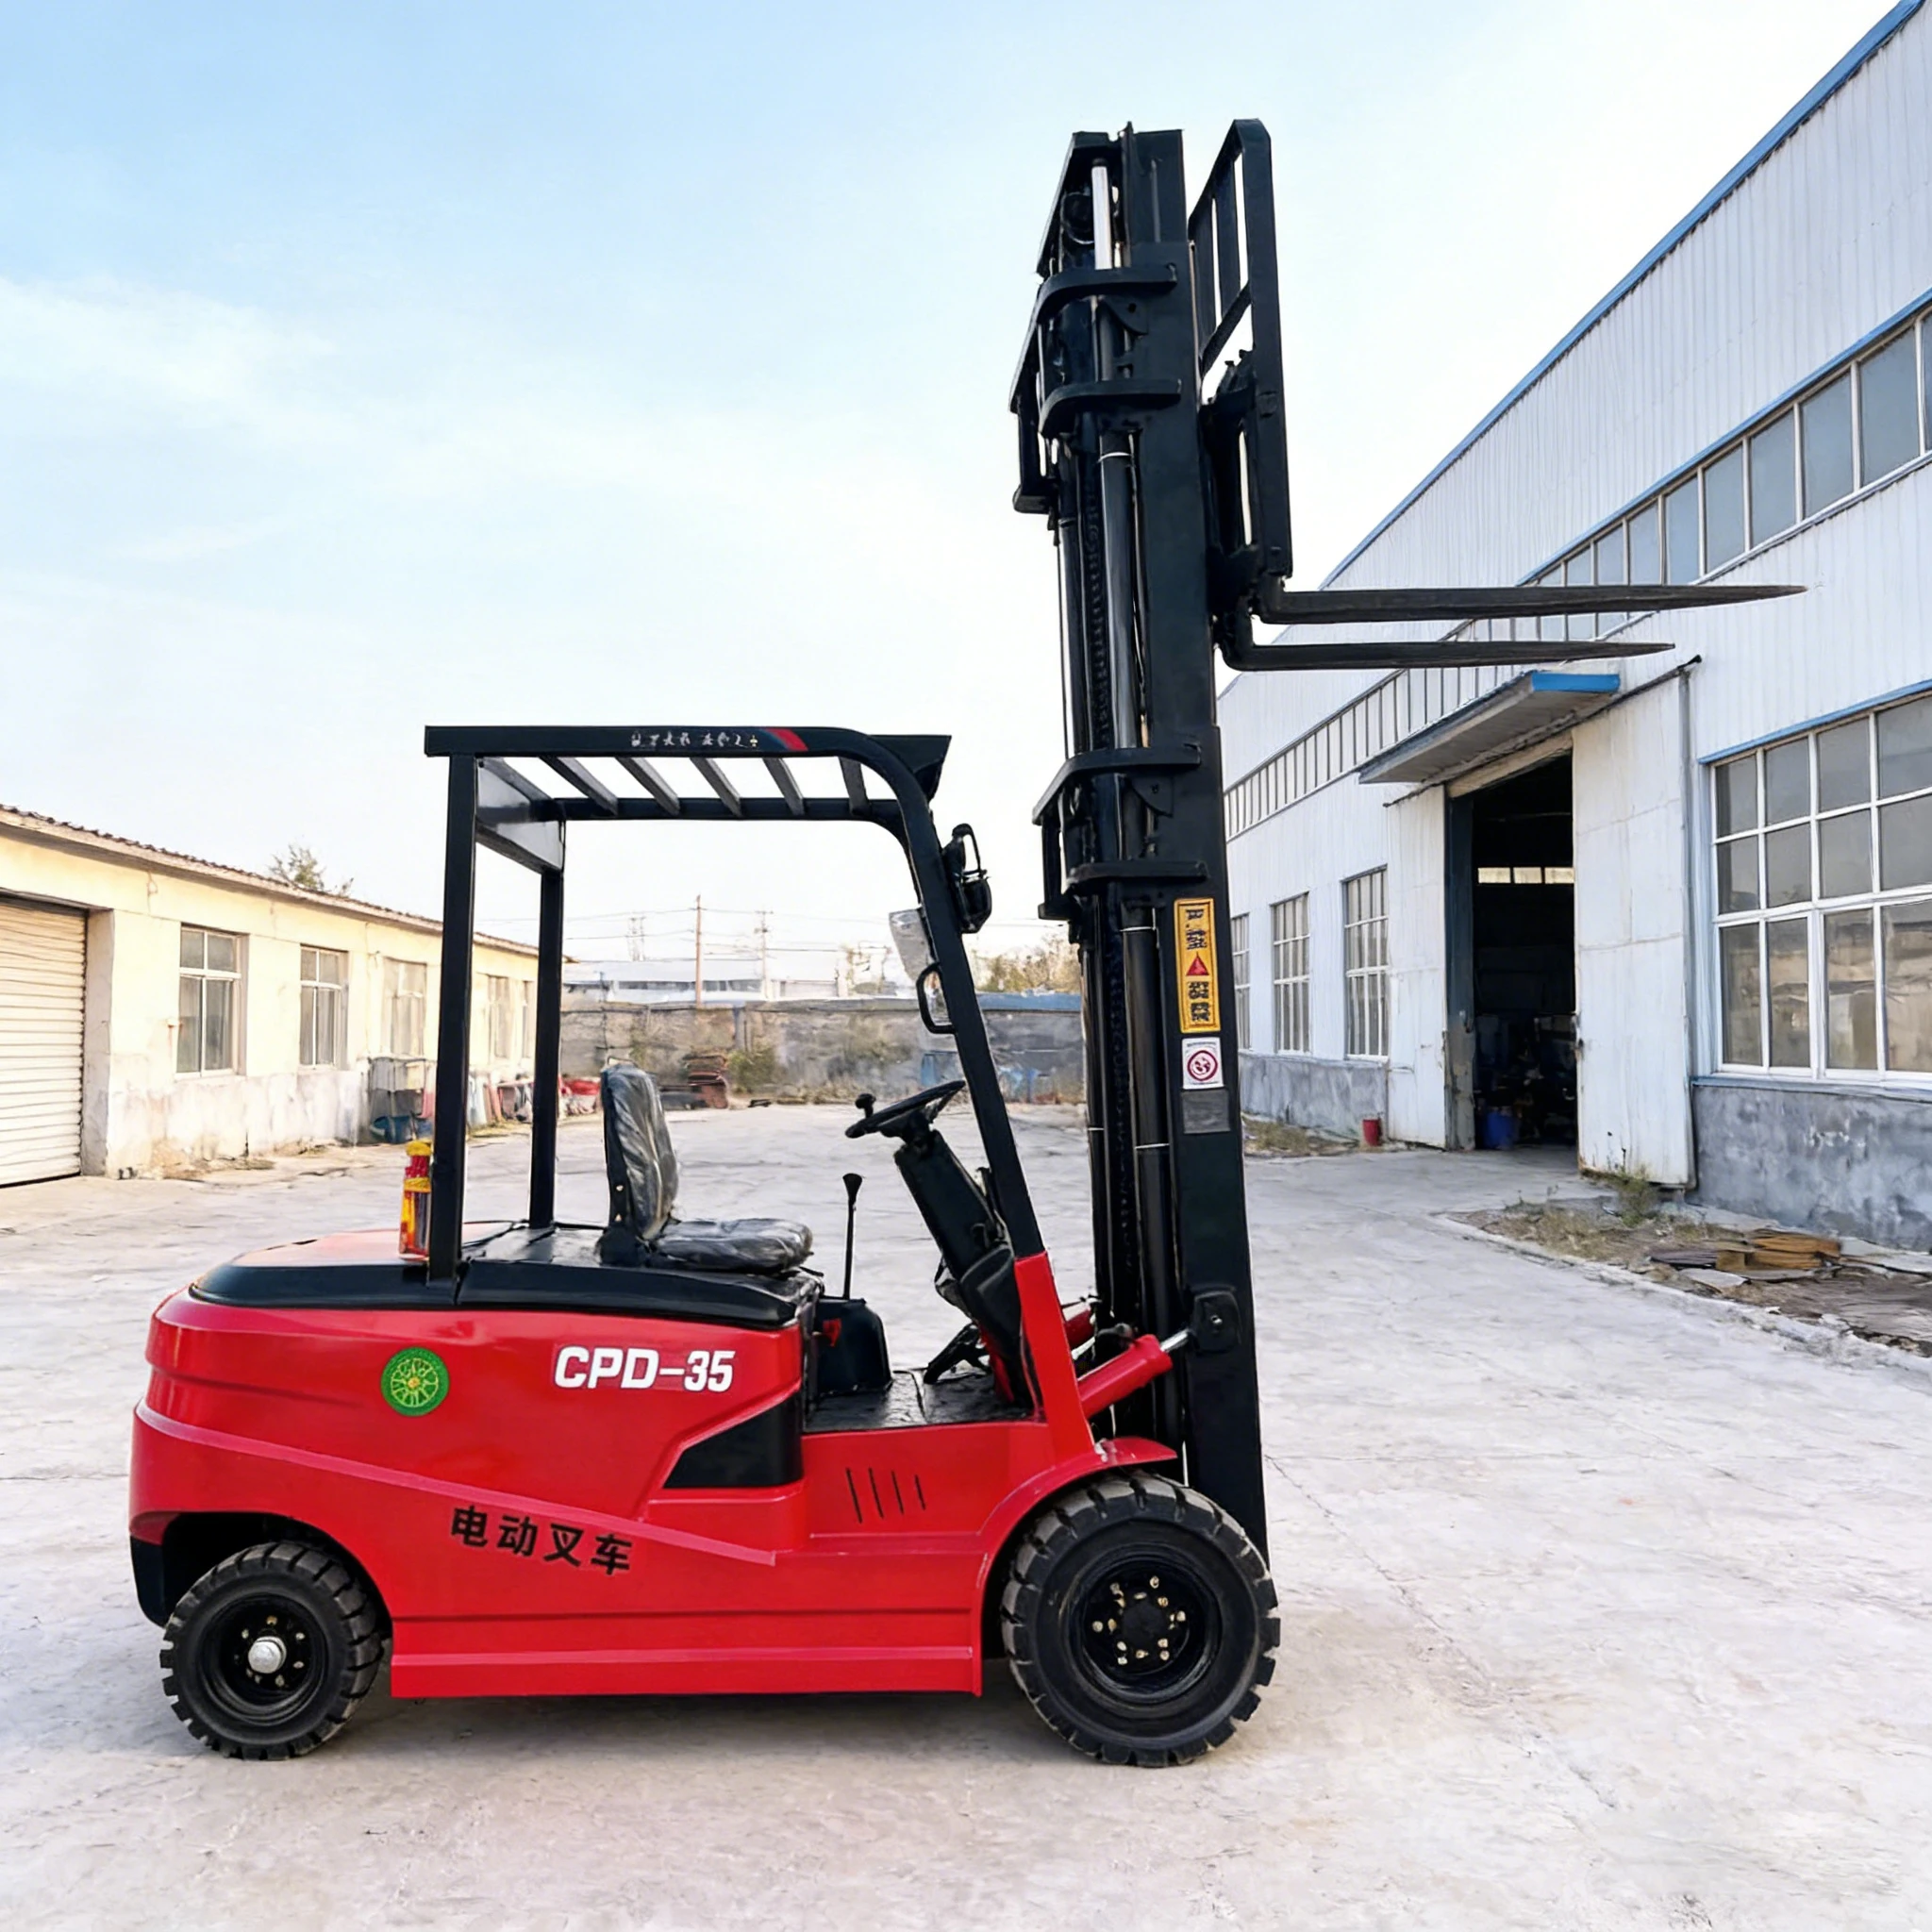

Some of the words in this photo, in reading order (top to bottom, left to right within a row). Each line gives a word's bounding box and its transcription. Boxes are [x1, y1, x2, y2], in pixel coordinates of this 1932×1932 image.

[555, 1345, 736, 1392] CPD-35
[451, 1505, 632, 1575] 电动叉车
